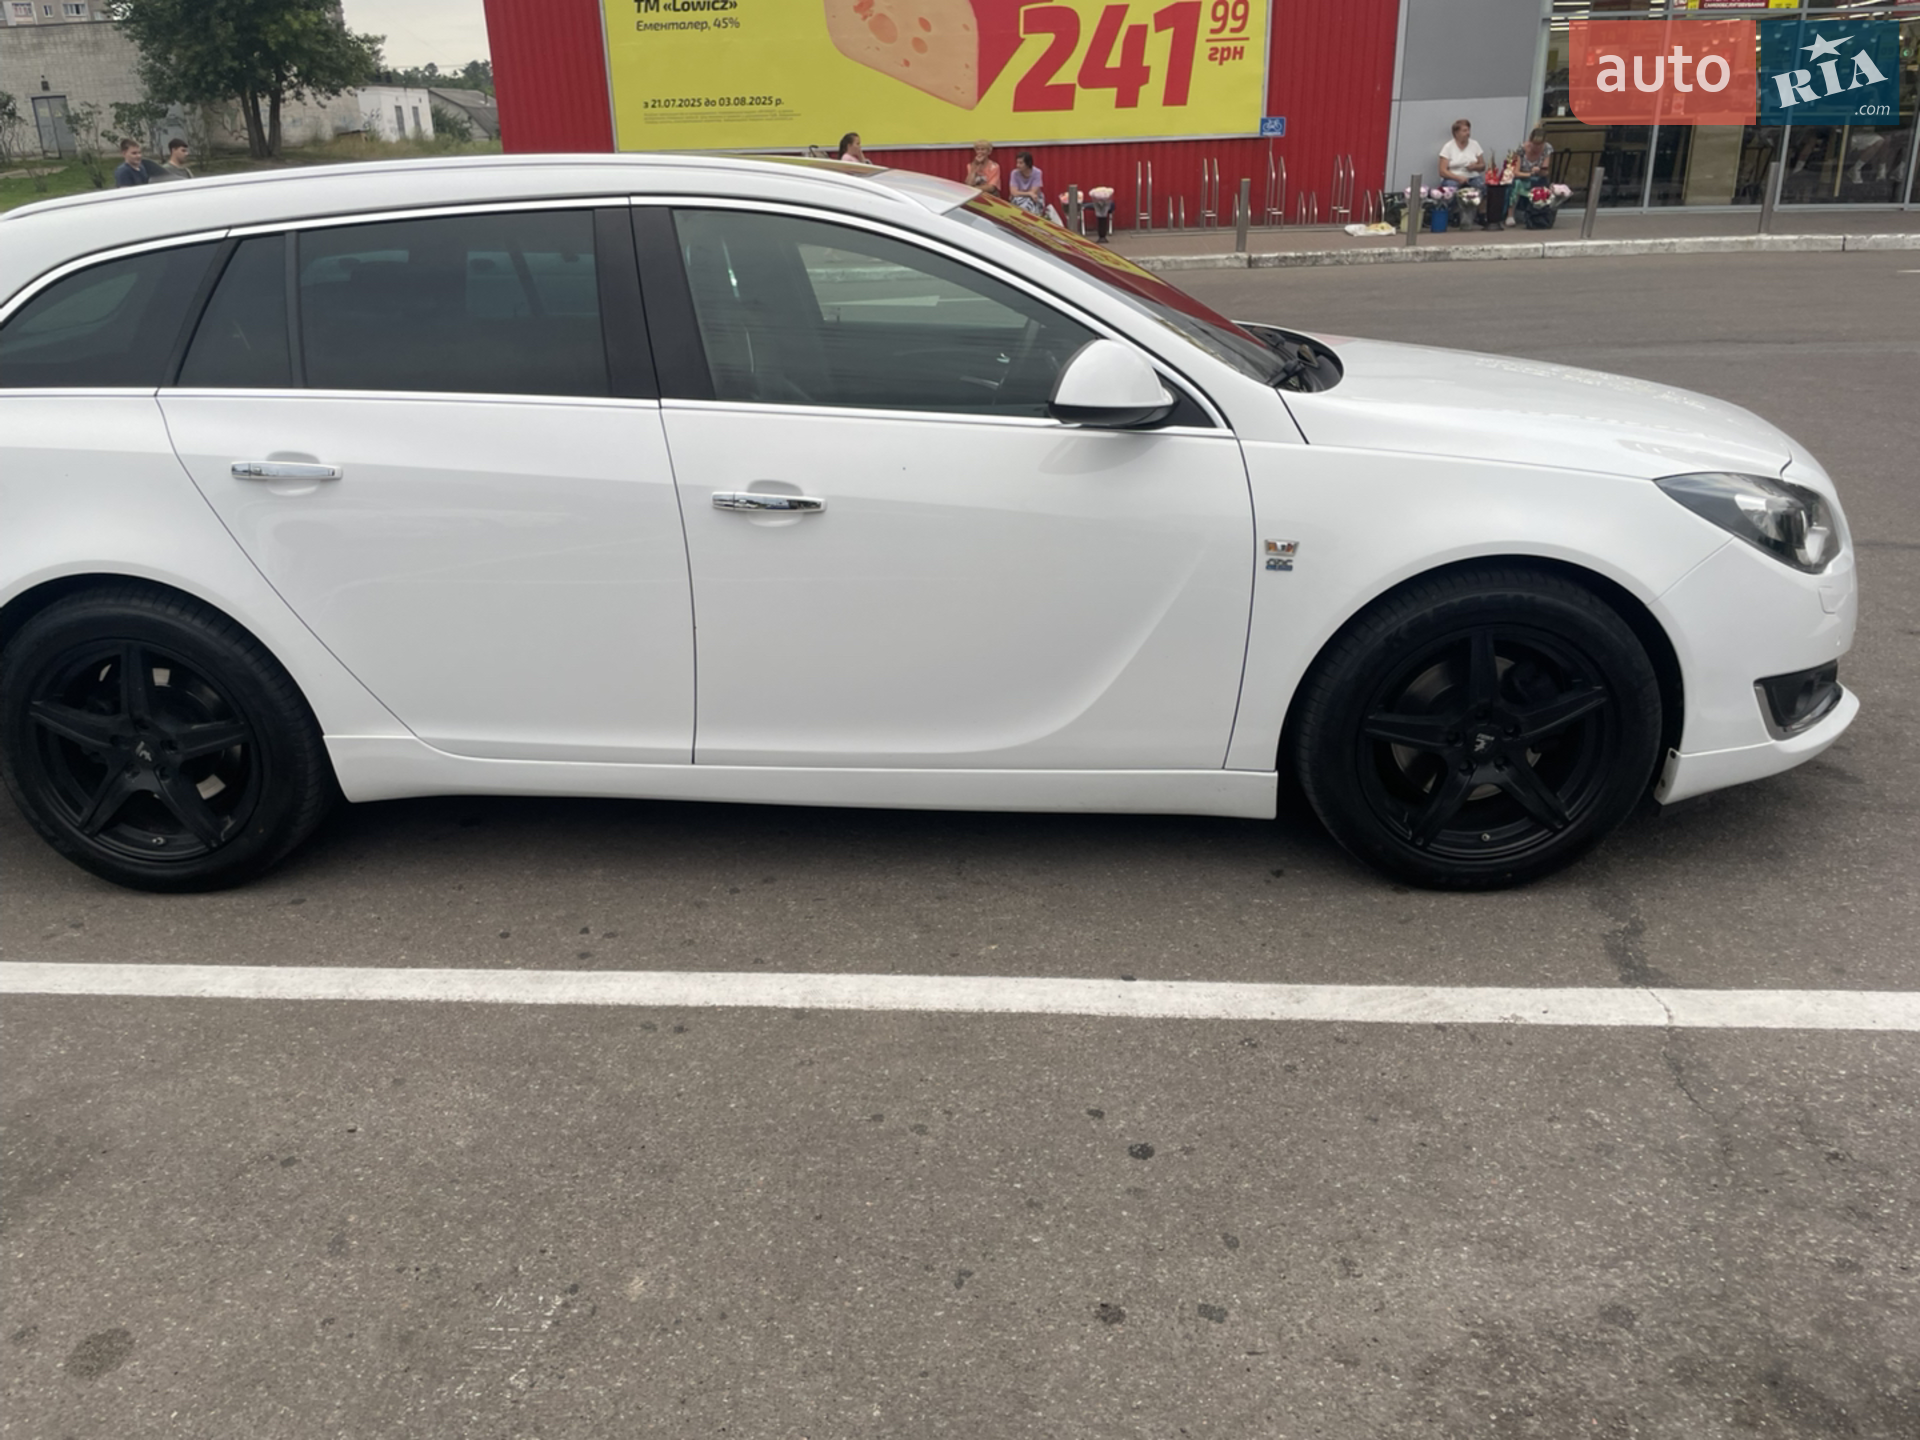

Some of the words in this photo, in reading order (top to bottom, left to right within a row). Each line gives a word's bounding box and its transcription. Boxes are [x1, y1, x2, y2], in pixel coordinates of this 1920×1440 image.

[637, 20, 710, 33] Ементалер,
[713, 17, 740, 30] 45%
[1209, 0, 1250, 35] 99
[1012, 1, 1202, 113] 241
[1208, 45, 1245, 66] грн
[651, 98, 702, 109] 21.07.2025
[704, 97, 717, 108] до
[718, 96, 773, 108] 03.08.2025
